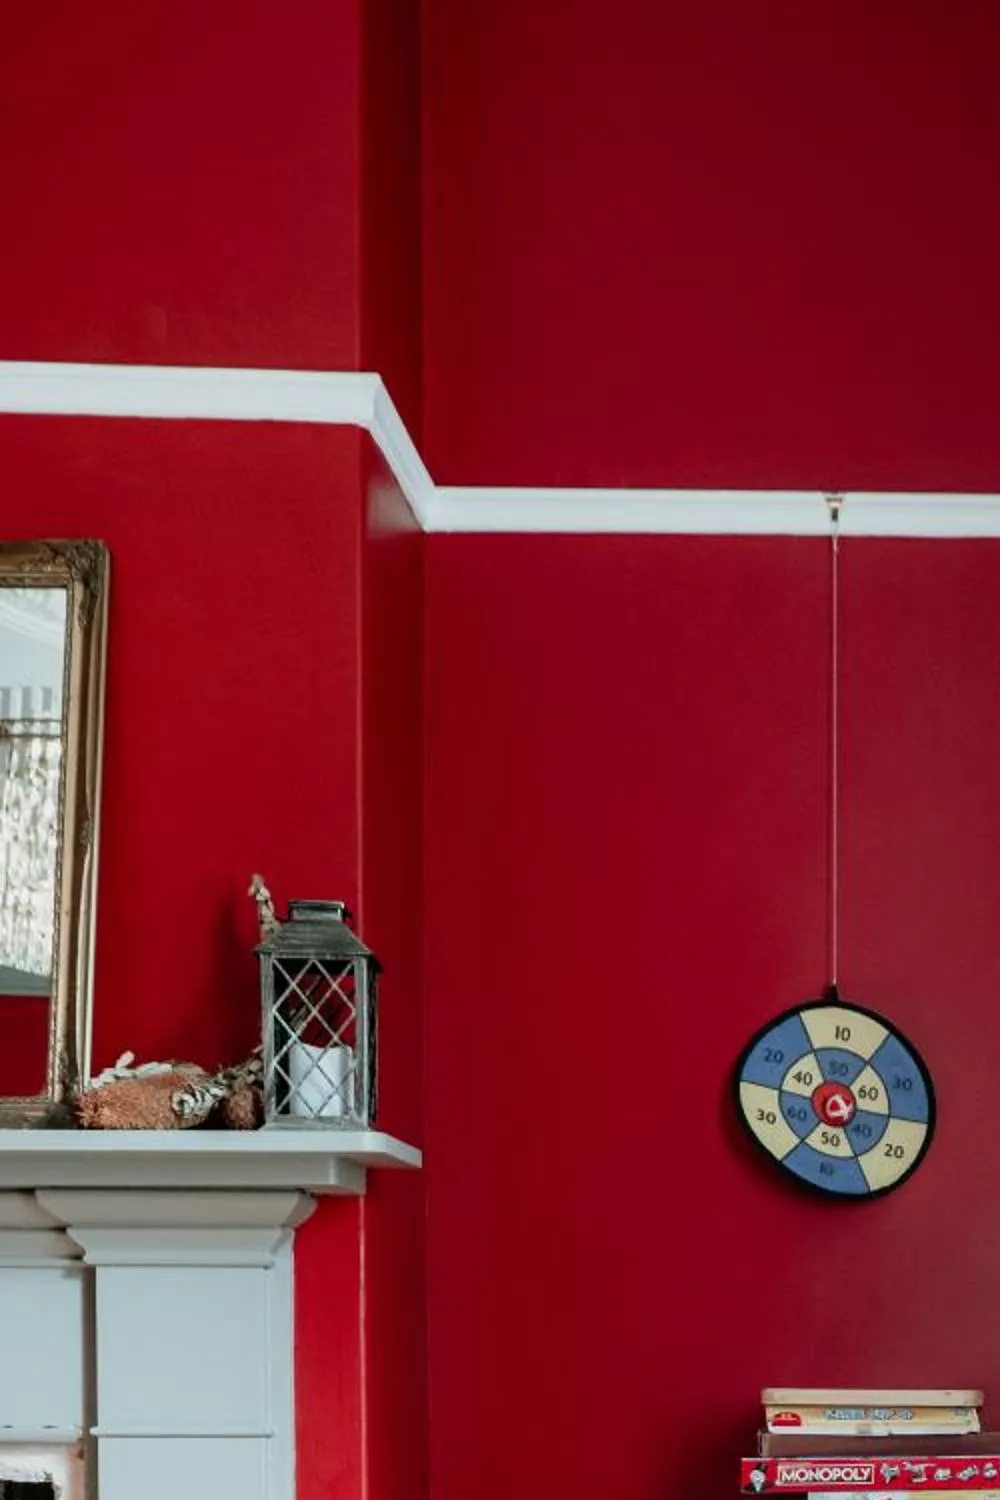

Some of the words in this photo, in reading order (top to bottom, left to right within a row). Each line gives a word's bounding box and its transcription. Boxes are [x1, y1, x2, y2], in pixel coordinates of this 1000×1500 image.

[834, 1026, 851, 1041] 10
[764, 1048, 784, 1063] 20
[792, 1071, 813, 1086] 40
[857, 1087, 879, 1101] 60
[757, 1109, 777, 1125] 30
[852, 1123, 873, 1139] 40
[820, 1132, 840, 1147] 50
[884, 1143, 905, 1159] 20
[819, 1162, 834, 1176] 10
[781, 1466, 872, 1483] MONOPOLY
